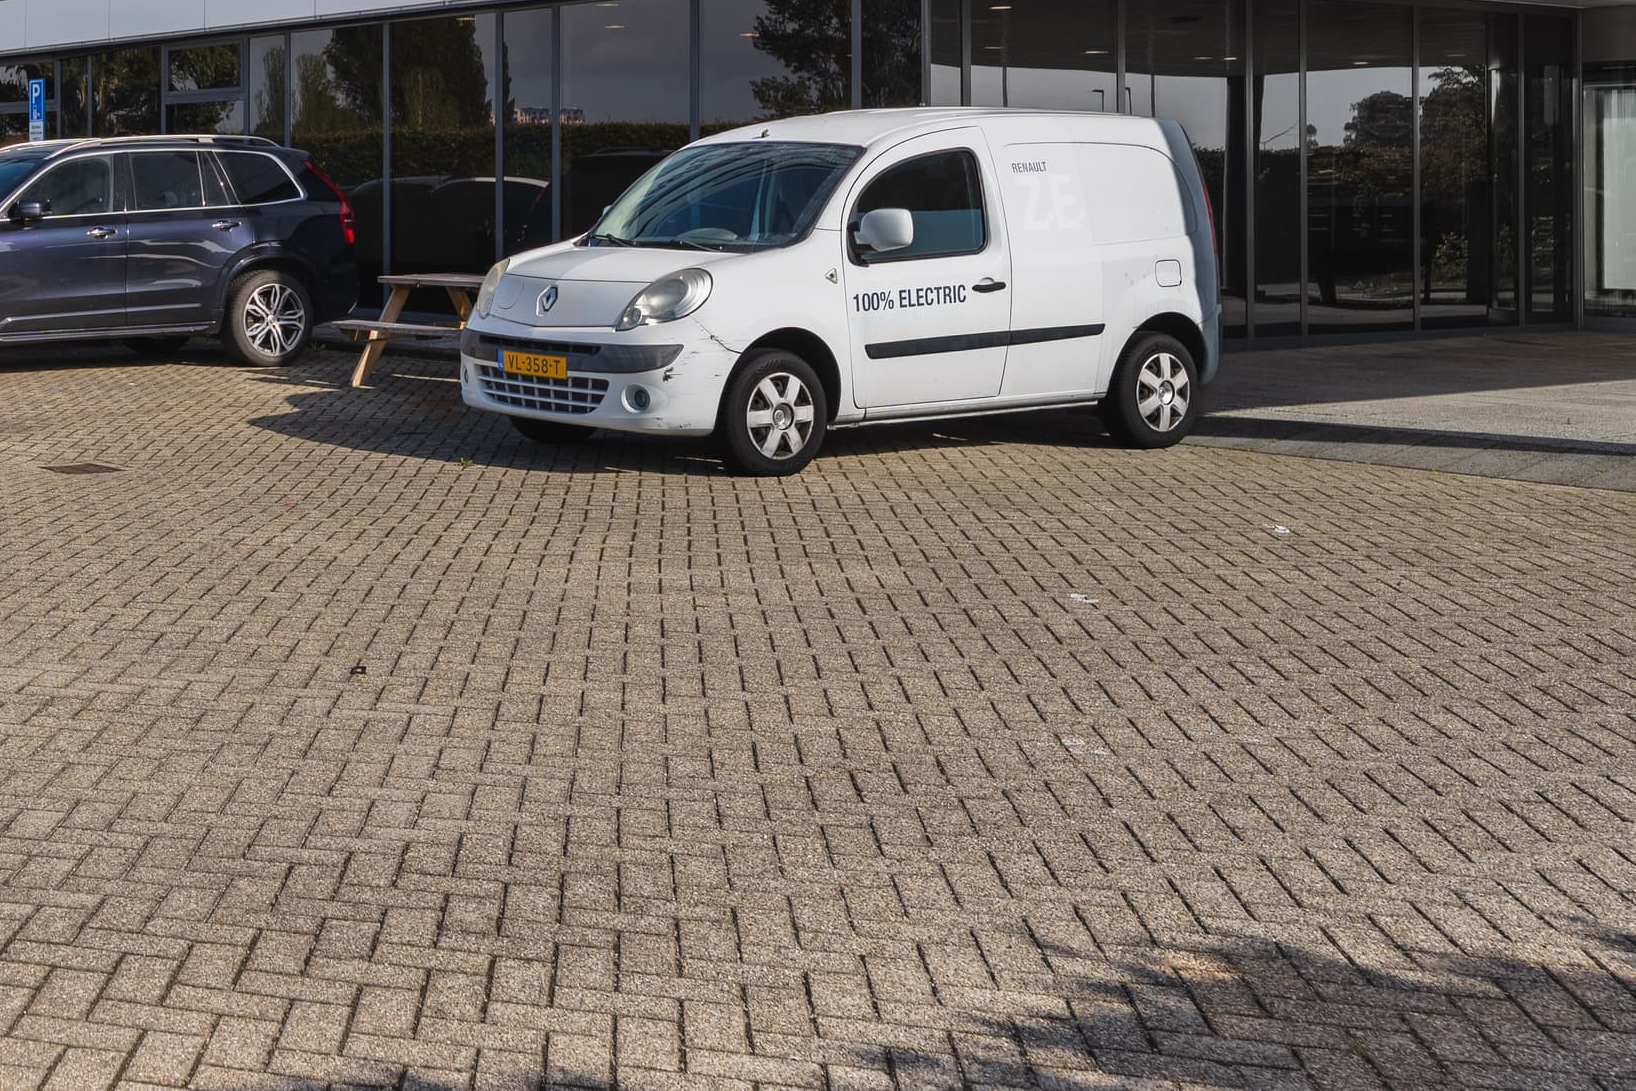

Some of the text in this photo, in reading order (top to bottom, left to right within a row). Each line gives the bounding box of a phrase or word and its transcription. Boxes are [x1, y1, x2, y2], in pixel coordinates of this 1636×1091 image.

[32, 84, 41, 104] P
[1011, 161, 1047, 173] RENAULT
[853, 285, 966, 312] 100% ELECTRIC
[508, 354, 561, 375] VL-358-T
